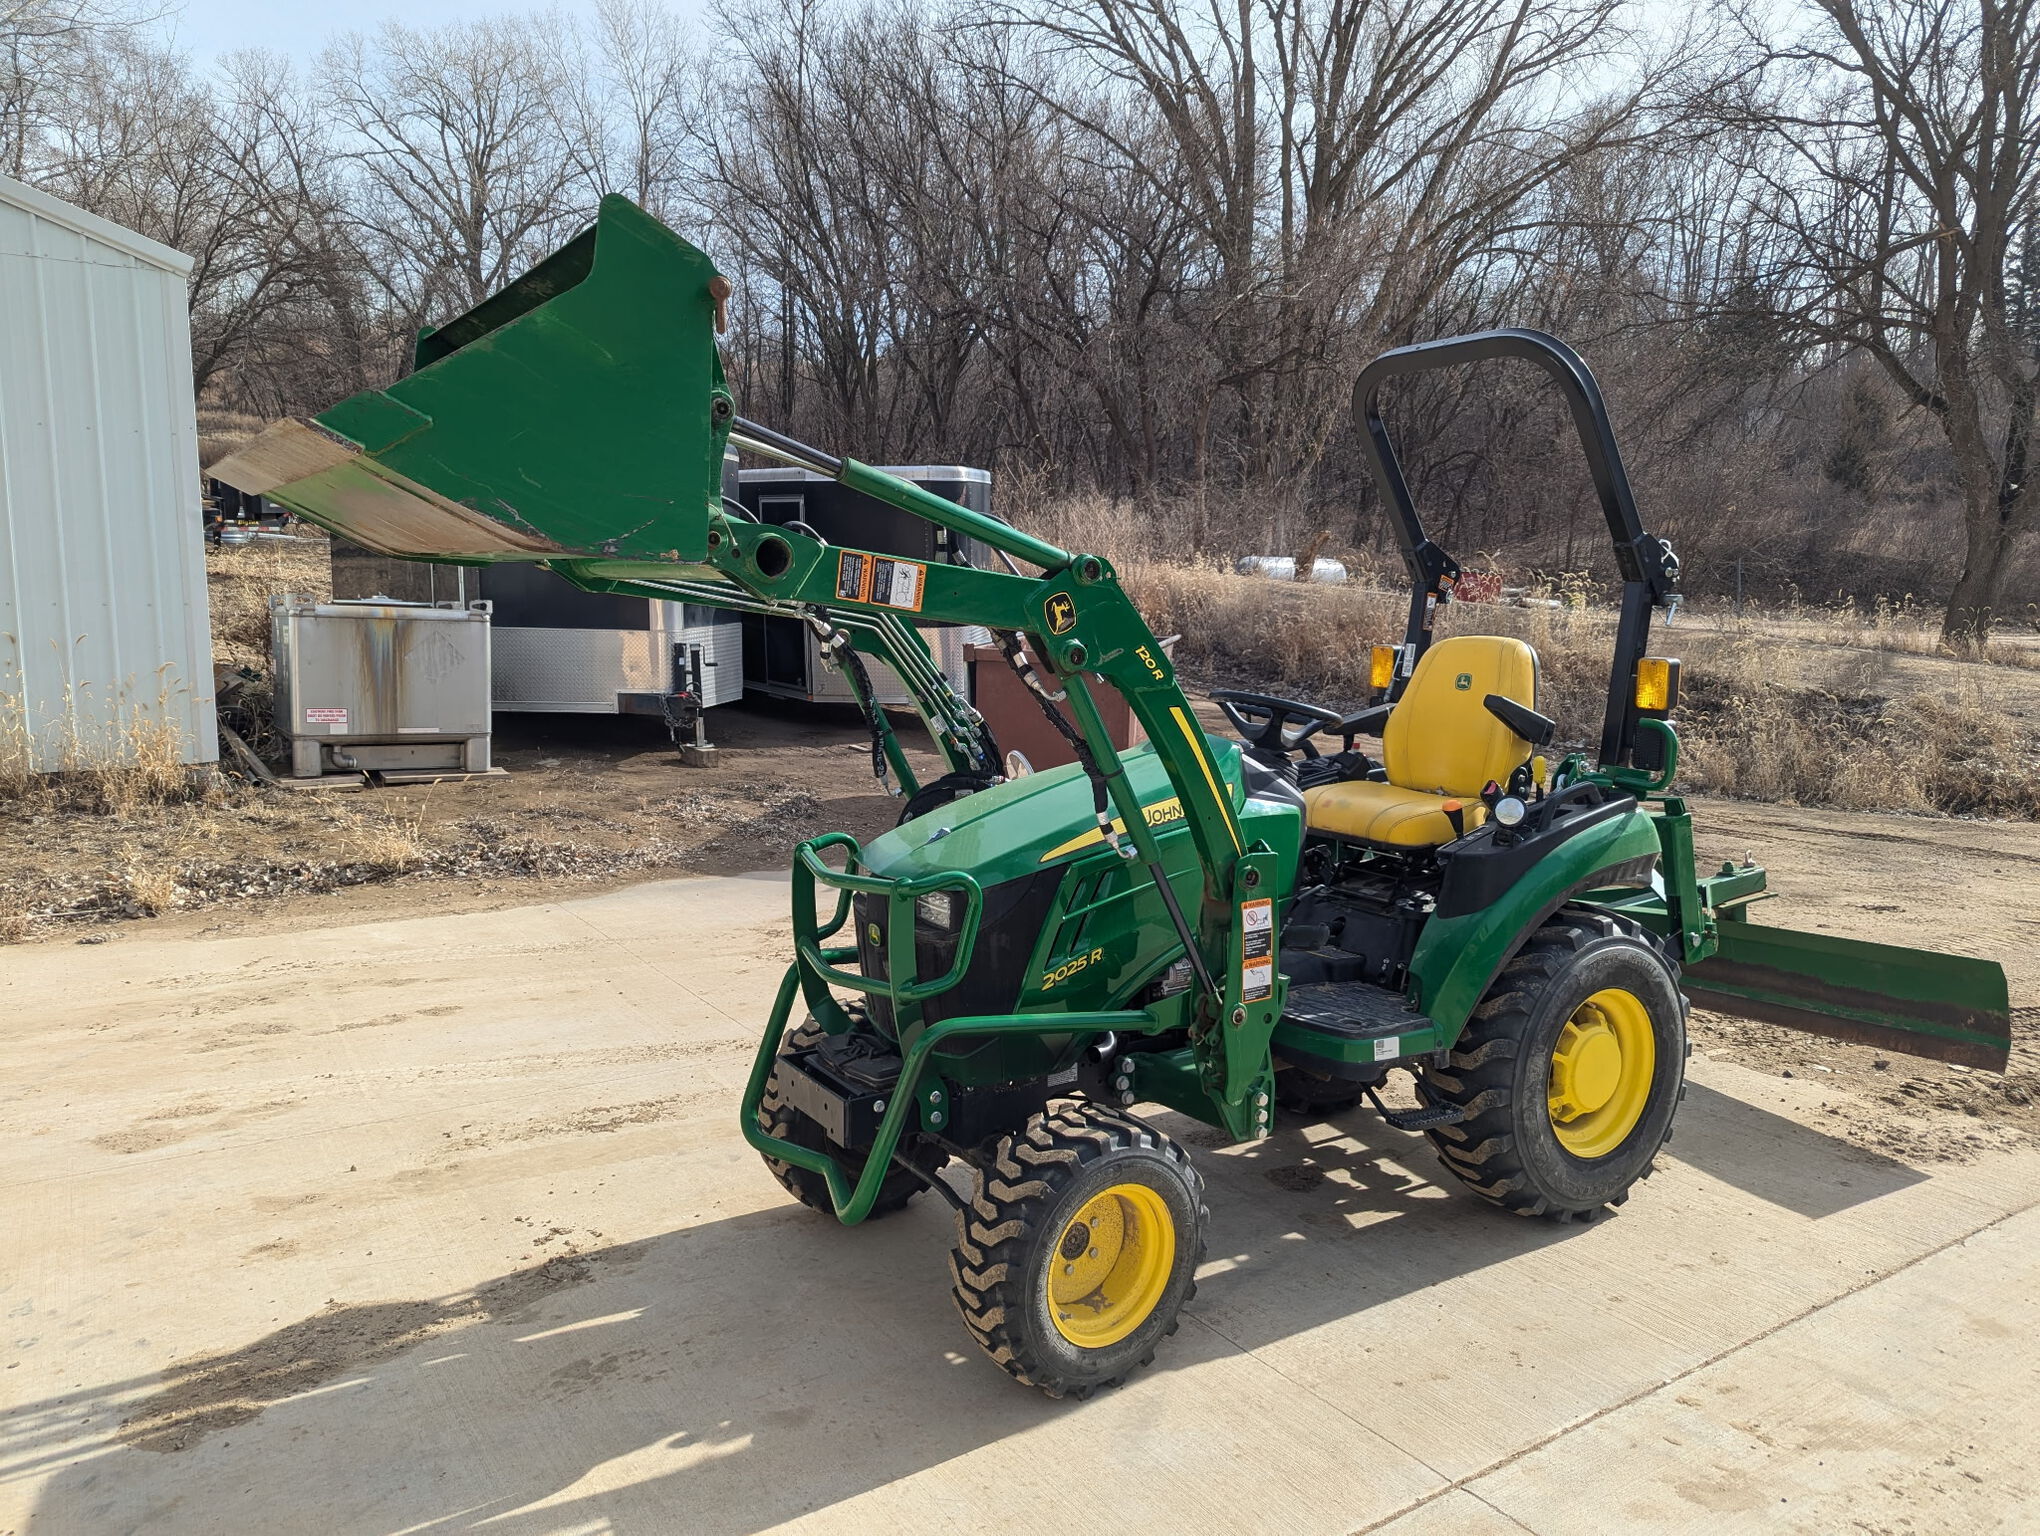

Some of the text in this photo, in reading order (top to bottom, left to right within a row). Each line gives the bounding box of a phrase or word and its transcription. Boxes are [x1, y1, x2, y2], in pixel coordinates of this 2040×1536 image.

[915, 576, 924, 607] WARNING
[1135, 645, 1164, 680] 120 R
[1148, 803, 1182, 823] JOHN
[1041, 948, 1103, 991] 2025 R
[1248, 959, 1271, 969] WARNING
